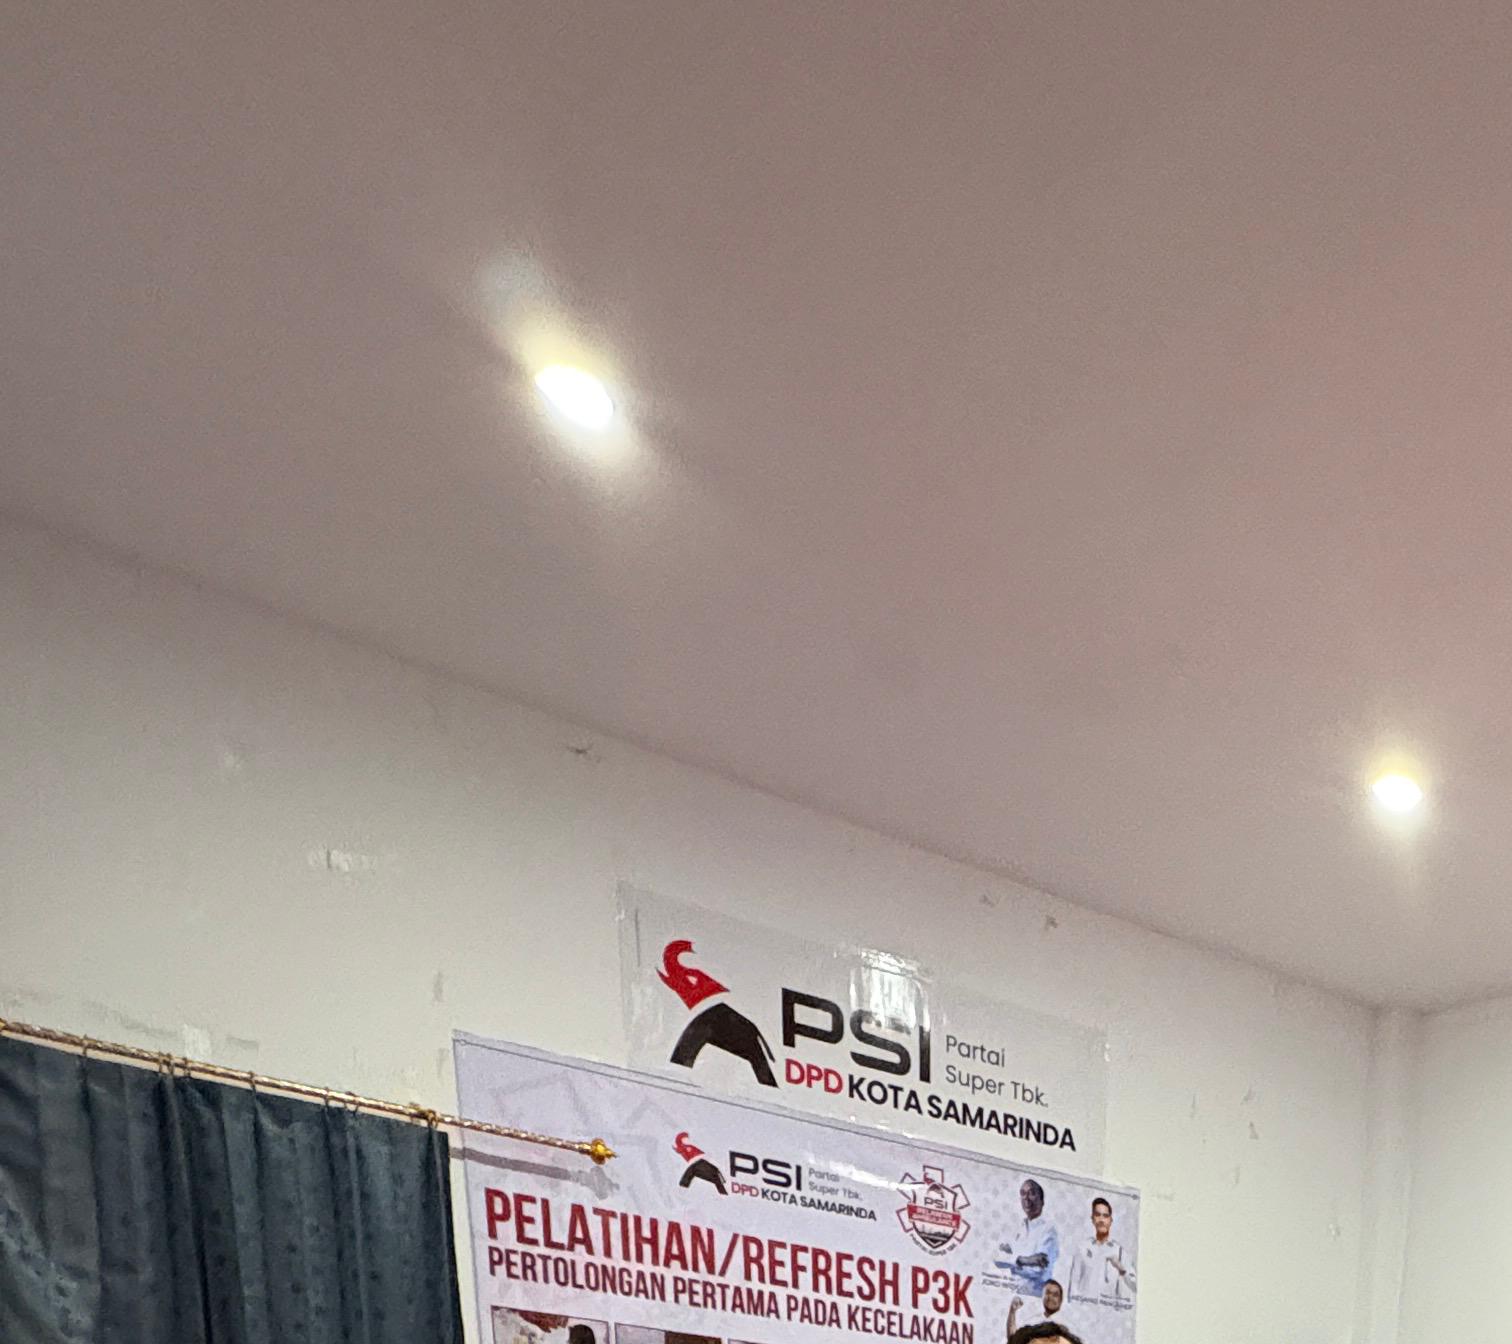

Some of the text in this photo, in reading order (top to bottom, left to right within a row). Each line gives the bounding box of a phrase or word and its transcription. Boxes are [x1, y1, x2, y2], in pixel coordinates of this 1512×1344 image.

[781, 987, 931, 1083] PSI
[945, 1034, 1006, 1068] Partai
[785, 1058, 1077, 1152] DPD KOTA SAMARINDA
[945, 1065, 1049, 1108] Super Tbk.
[729, 1150, 802, 1191] PSI
[808, 1181, 840, 1197] Super
[731, 1182, 878, 1222] DPD KOTA SAMARINDA
[923, 1196, 949, 1210] PSI
[485, 1187, 975, 1319] PELATIHAN/REFRESH P3K
[488, 1246, 666, 1303] PERTOLONGAN
[673, 1275, 781, 1320] PERTAMA
[786, 1294, 842, 1329] PADA
